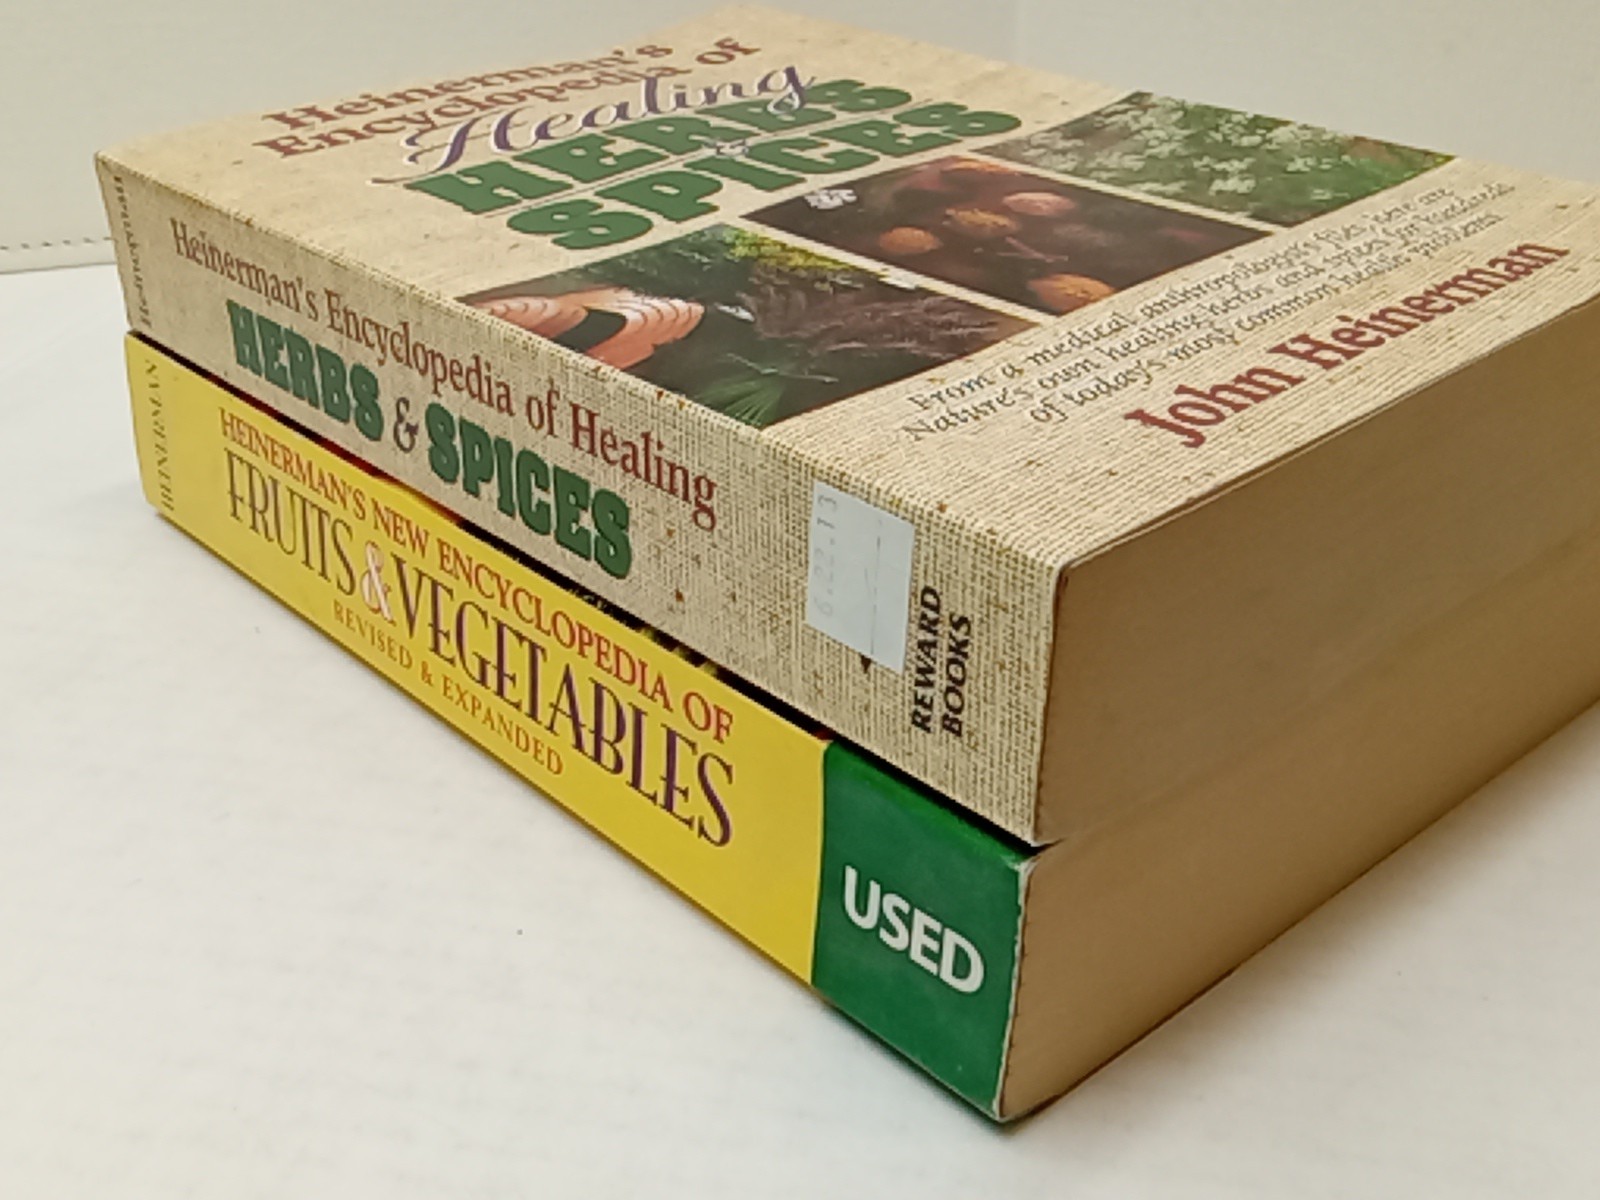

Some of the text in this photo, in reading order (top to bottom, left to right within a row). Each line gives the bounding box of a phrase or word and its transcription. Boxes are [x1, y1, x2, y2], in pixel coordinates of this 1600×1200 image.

[252, 62, 692, 159] Encyclopedia
[262, 44, 674, 131] Heinerman's
[369, 63, 816, 186] Healing
[403, 79, 913, 216] HERBS
[506, 103, 1022, 251] SPICES
[169, 216, 319, 323] Heinerman's
[323, 286, 516, 417] Encyclopedia
[525, 385, 560, 439] of
[568, 400, 717, 532] Healing
[901, 384, 1033, 442] Nature's
[1037, 355, 1103, 390] own
[1095, 312, 1207, 363] healing
[1203, 283, 1273, 318] herbs
[1274, 263, 1326, 289] and
[907, 370, 996, 412] From
[1001, 361, 1025, 379] a
[1026, 310, 1138, 367] medical
[1029, 399, 1070, 424] of
[1070, 356, 1167, 410] today's
[1165, 321, 1242, 363] most
[1233, 279, 1341, 333] common
[1123, 240, 1569, 449] John Heinerman
[226, 298, 632, 580] HERBS & SPICES
[218, 406, 734, 744] HEINERMAN'S NEW ENCYCLOPEDIA OF
[223, 446, 734, 849] FRUITS & VEGETABLES
[333, 599, 564, 776] REVISED & EXPANDED
[911, 586, 942, 735] REWARD
[940, 611, 972, 738] BOOKS
[844, 864, 985, 994] USED
